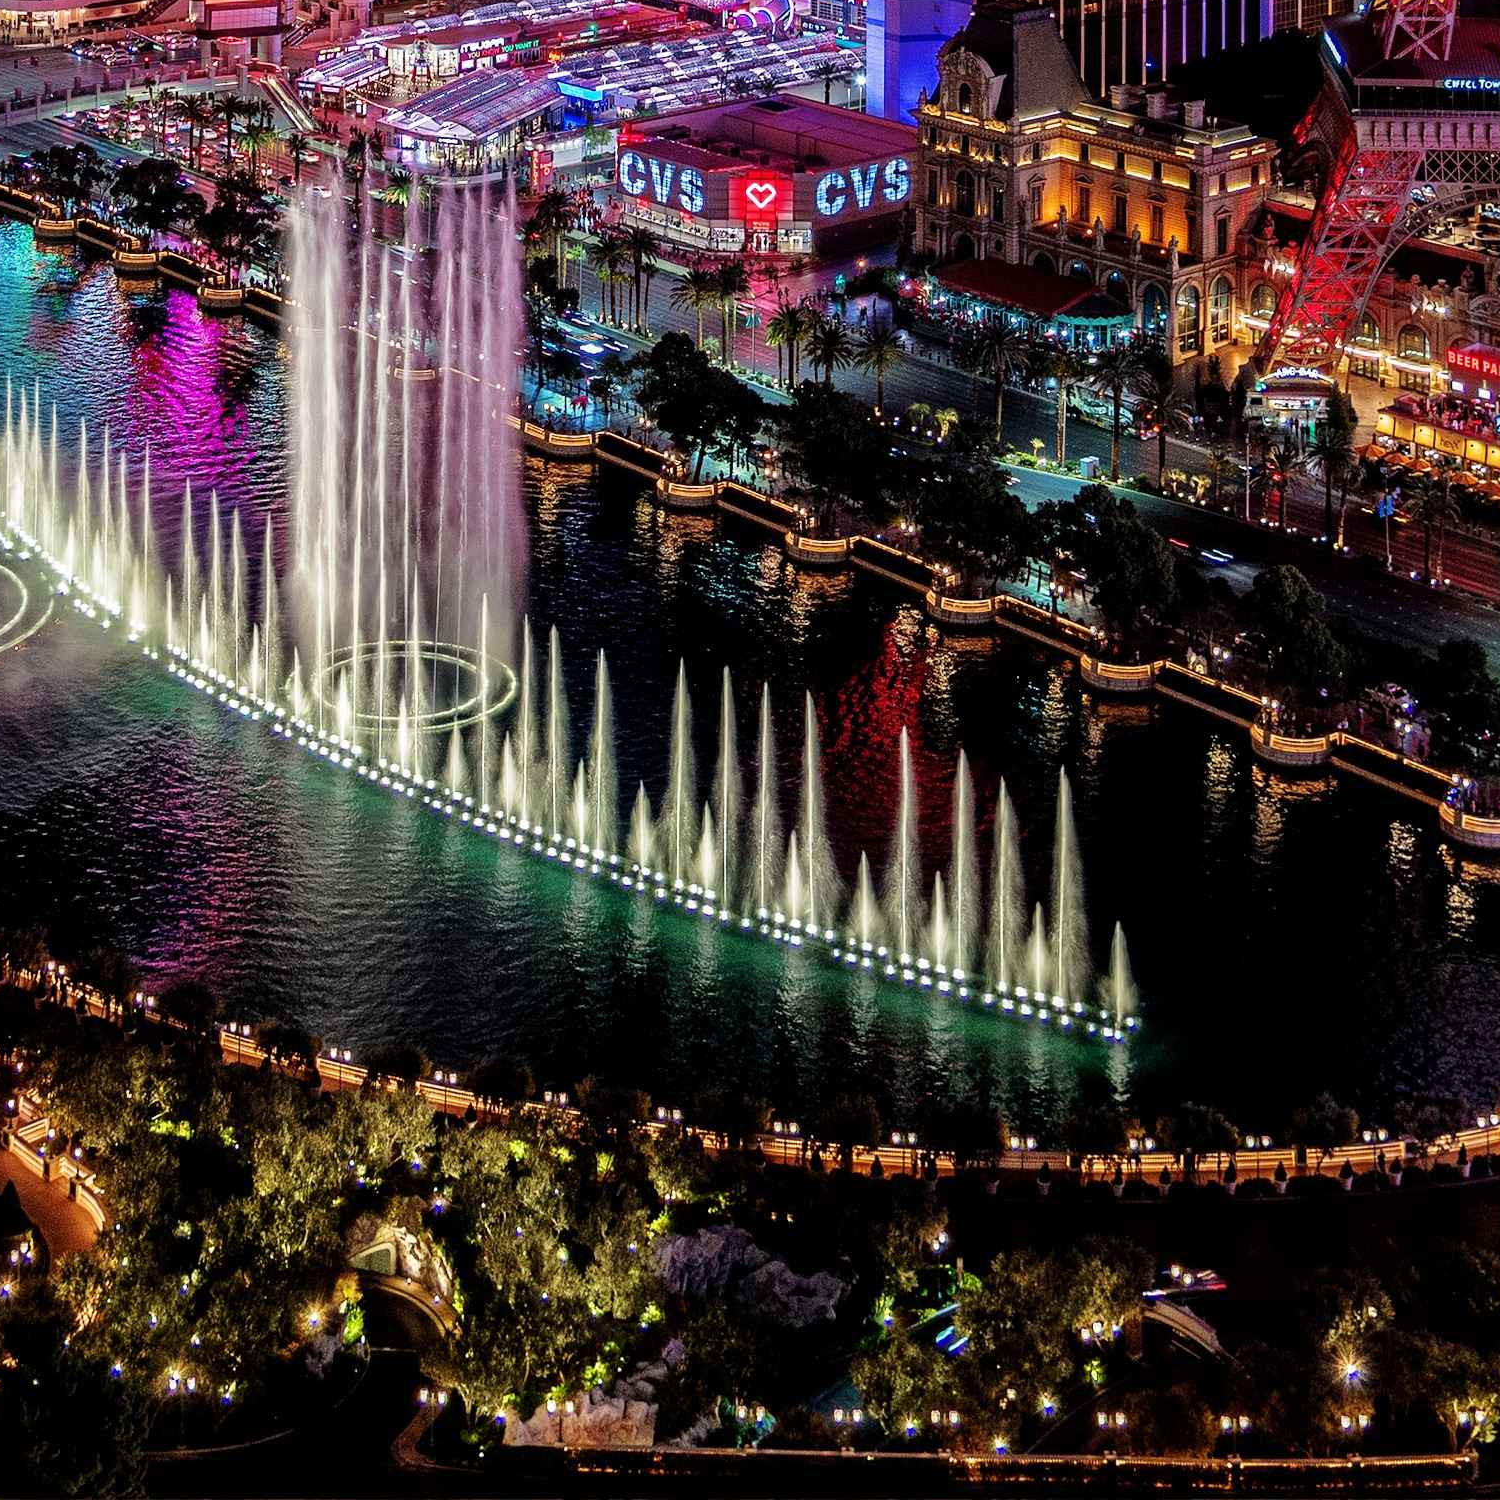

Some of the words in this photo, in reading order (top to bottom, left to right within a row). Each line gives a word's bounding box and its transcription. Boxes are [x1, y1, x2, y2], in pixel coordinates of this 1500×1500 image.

[468, 50, 481, 59] YOU
[502, 45, 514, 53] YOU
[514, 41, 533, 51] WANT
[1444, 79, 1477, 89] EIFFEL
[619, 151, 707, 213] CVS
[816, 157, 911, 216] CVS
[1448, 351, 1480, 370] BEER
